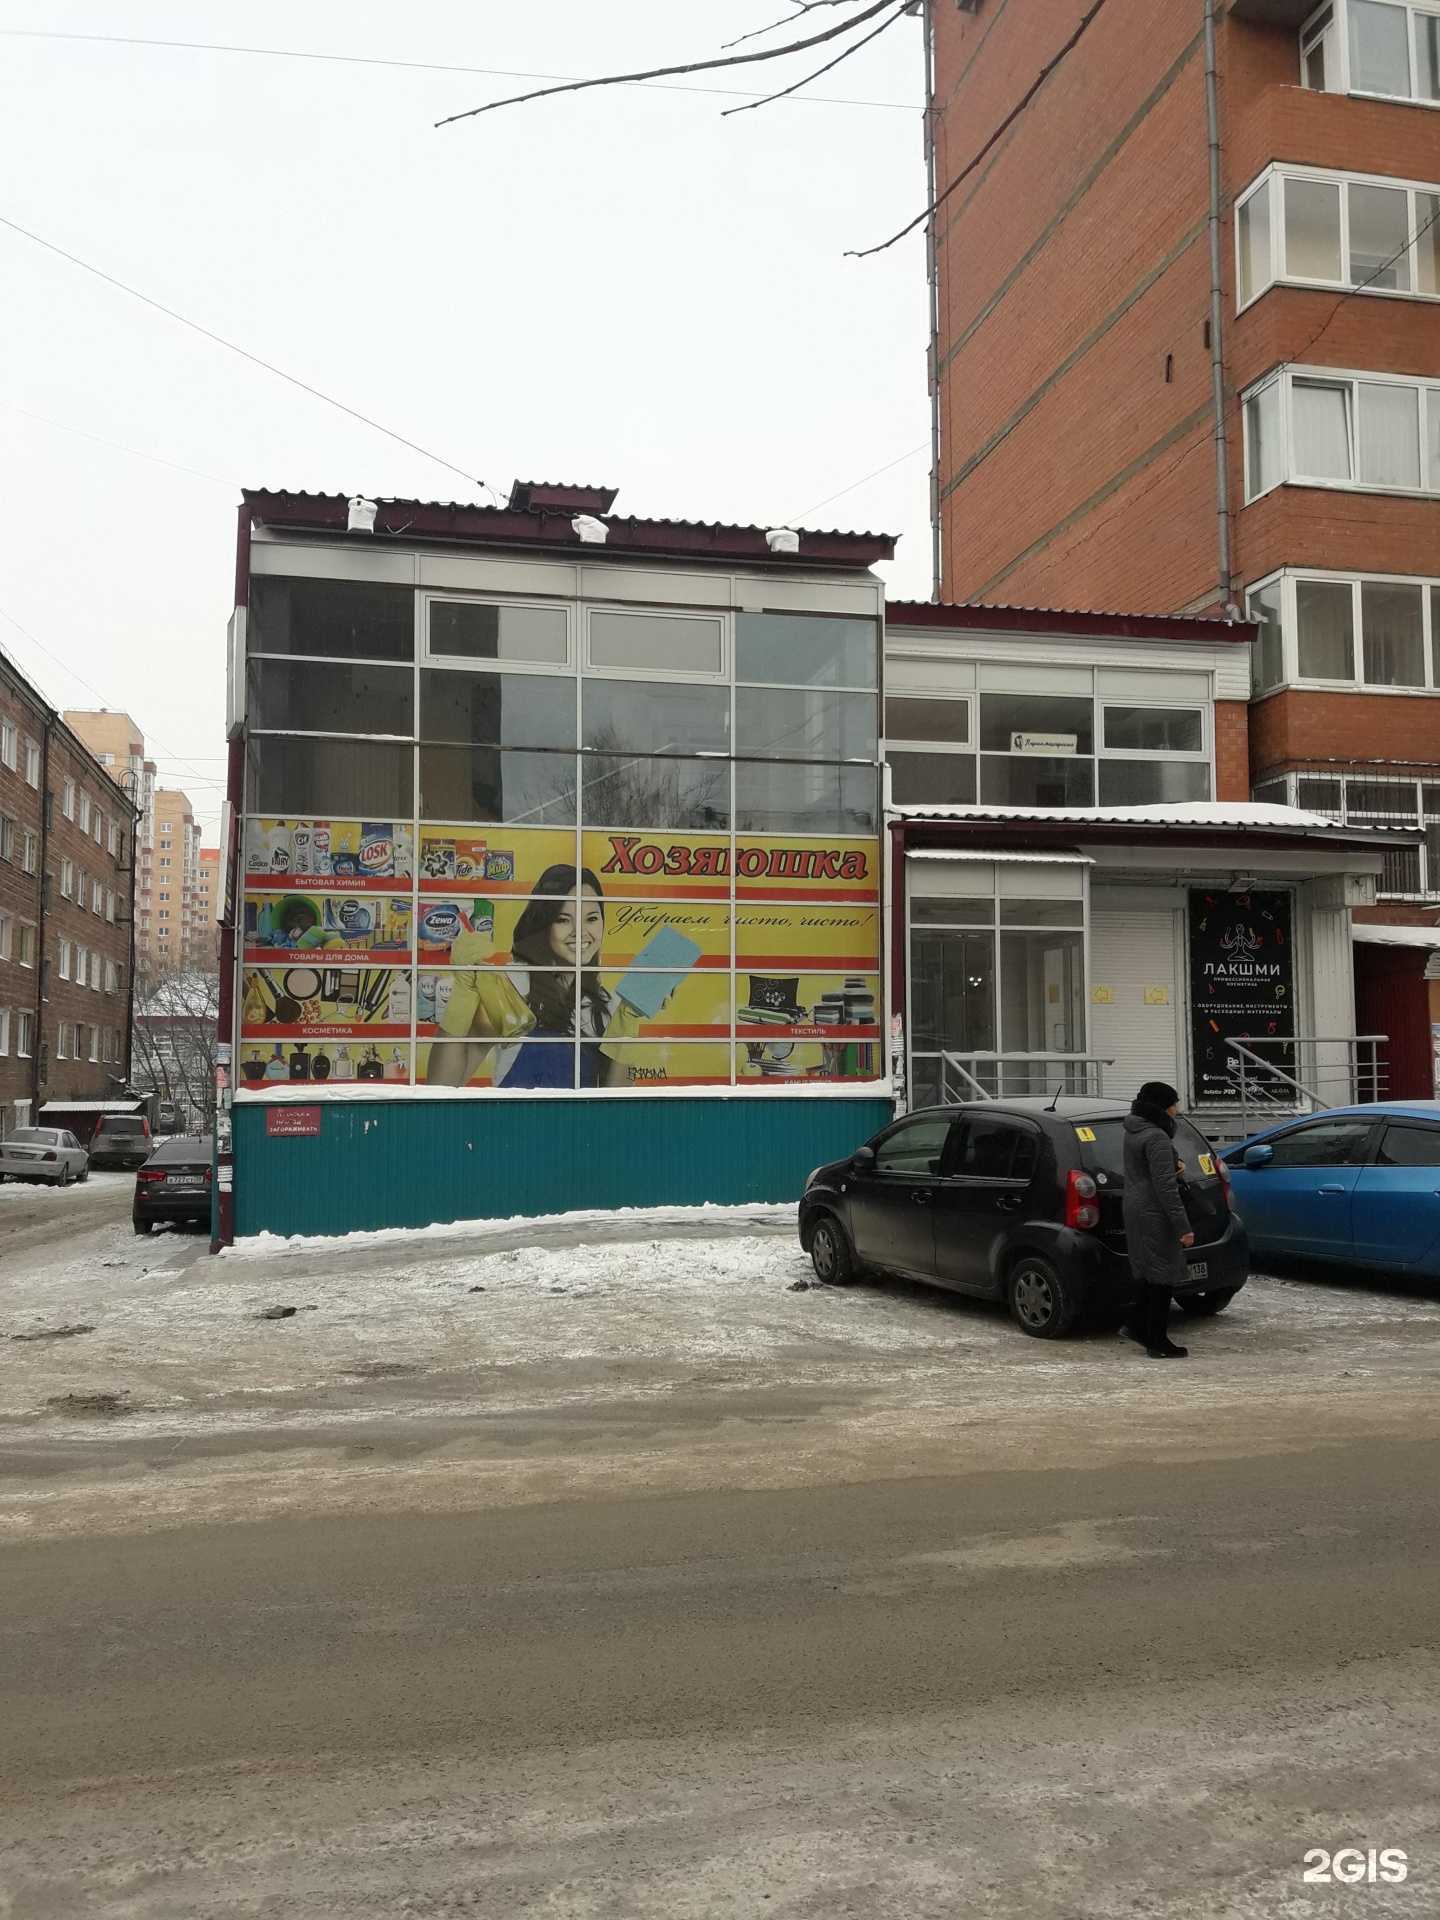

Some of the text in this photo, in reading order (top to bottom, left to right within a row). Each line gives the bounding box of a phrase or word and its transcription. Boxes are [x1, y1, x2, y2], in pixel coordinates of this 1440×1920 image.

[361, 843, 388, 862] LOSK
[601, 836, 869, 880] Хозяюшка
[456, 863, 473, 876] Tide
[295, 879, 366, 887] БЫТОВАЯ ХИМИЯ
[429, 916, 453, 925] Zewa
[608, 905, 711, 938] Убираем
[799, 913, 875, 928] чисто!
[289, 953, 324, 961] ТОВАРЫ
[325, 954, 343, 962] ДЛЯ
[1203, 963, 1281, 976] ЛАКШМИ
[302, 1027, 353, 1035] КОСМЕТИКА
[790, 1027, 826, 1035] ТЕКСТИЛЬ
